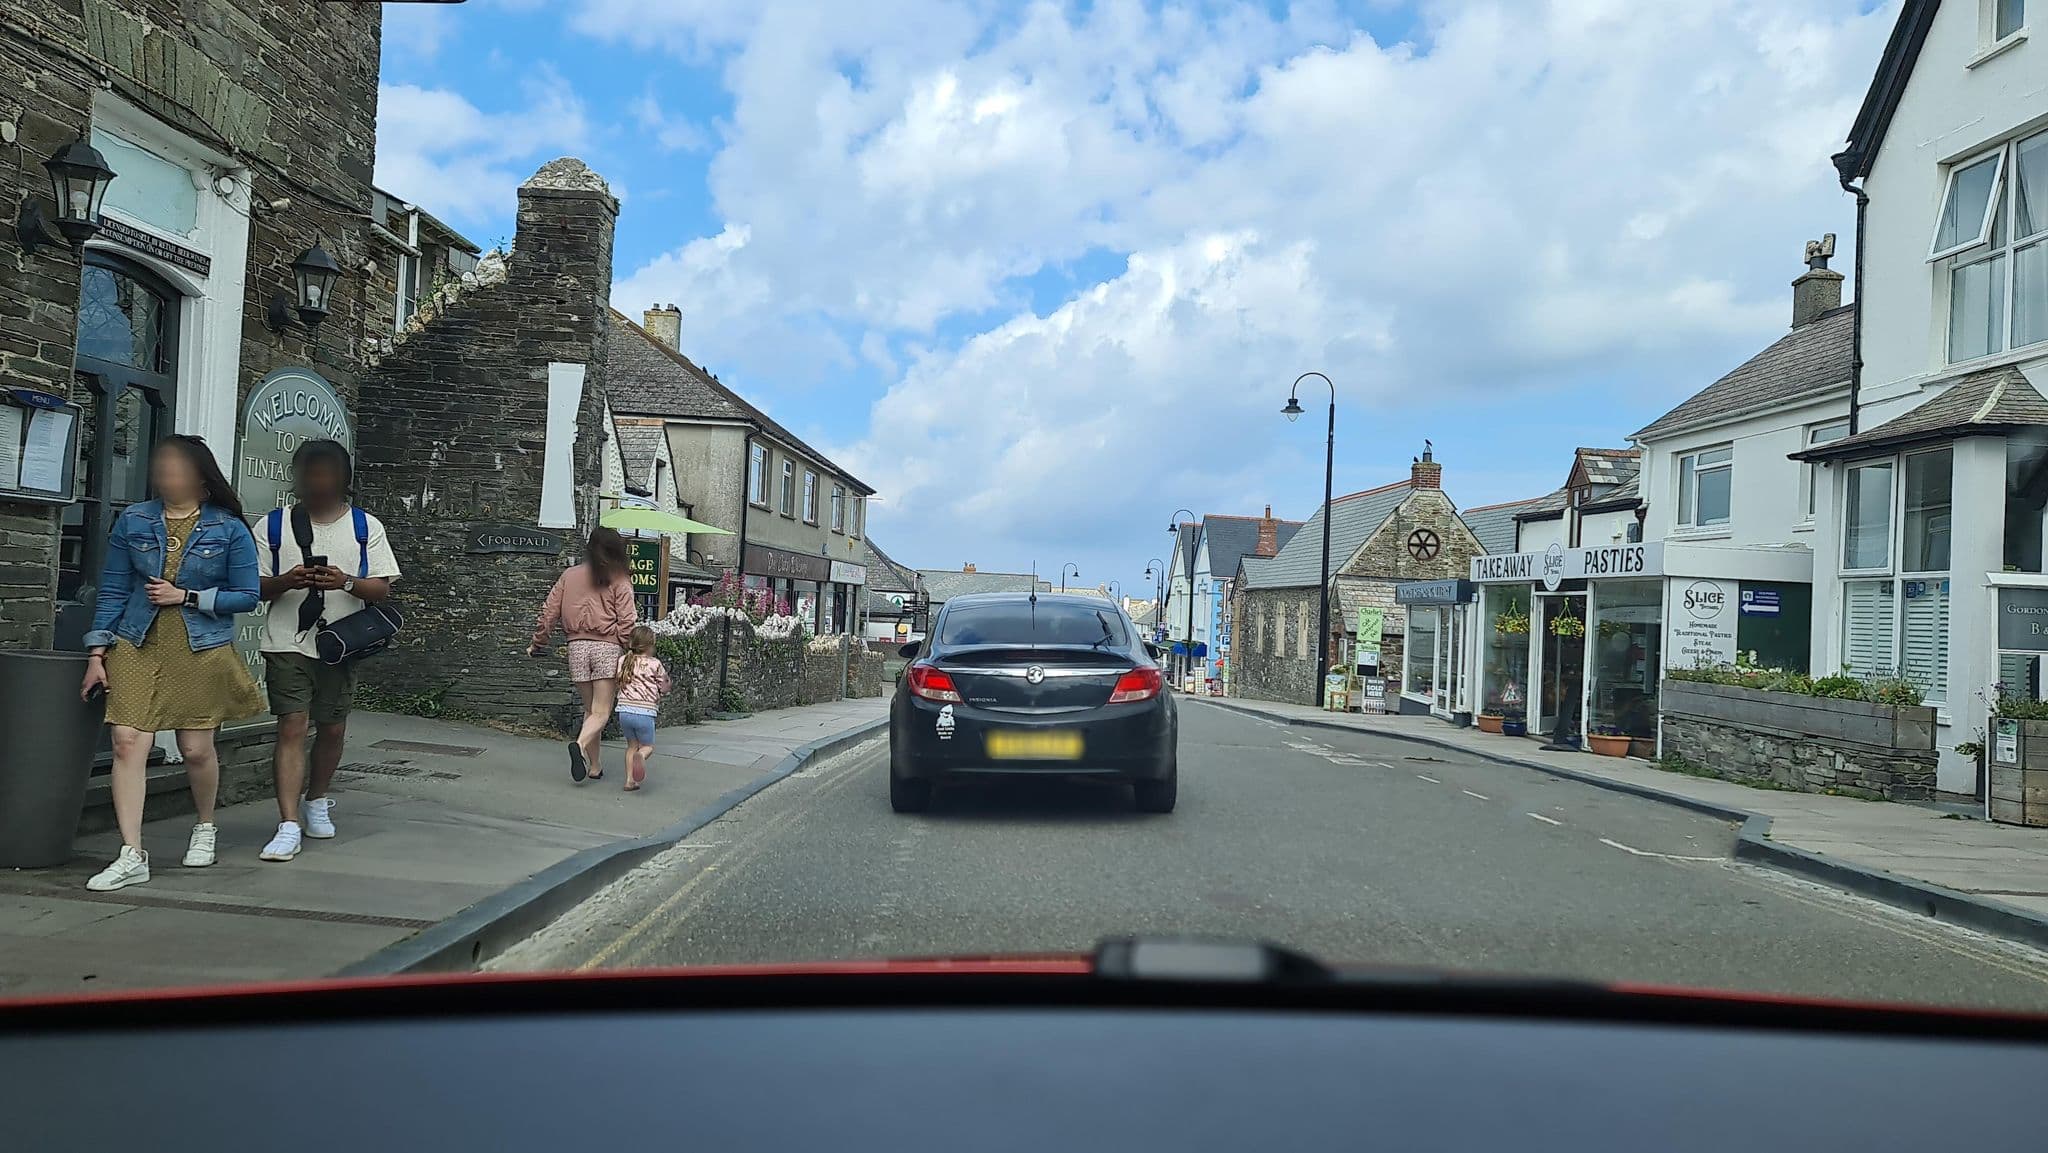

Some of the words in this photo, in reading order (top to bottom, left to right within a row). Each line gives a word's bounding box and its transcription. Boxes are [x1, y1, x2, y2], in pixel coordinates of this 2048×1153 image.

[254, 390, 344, 440] WELCOME
[275, 430, 295, 452] TO
[1476, 555, 1534, 579] TAKEAWAY
[1584, 547, 1644, 575] PASTIES
[2031, 622, 2040, 635] B
